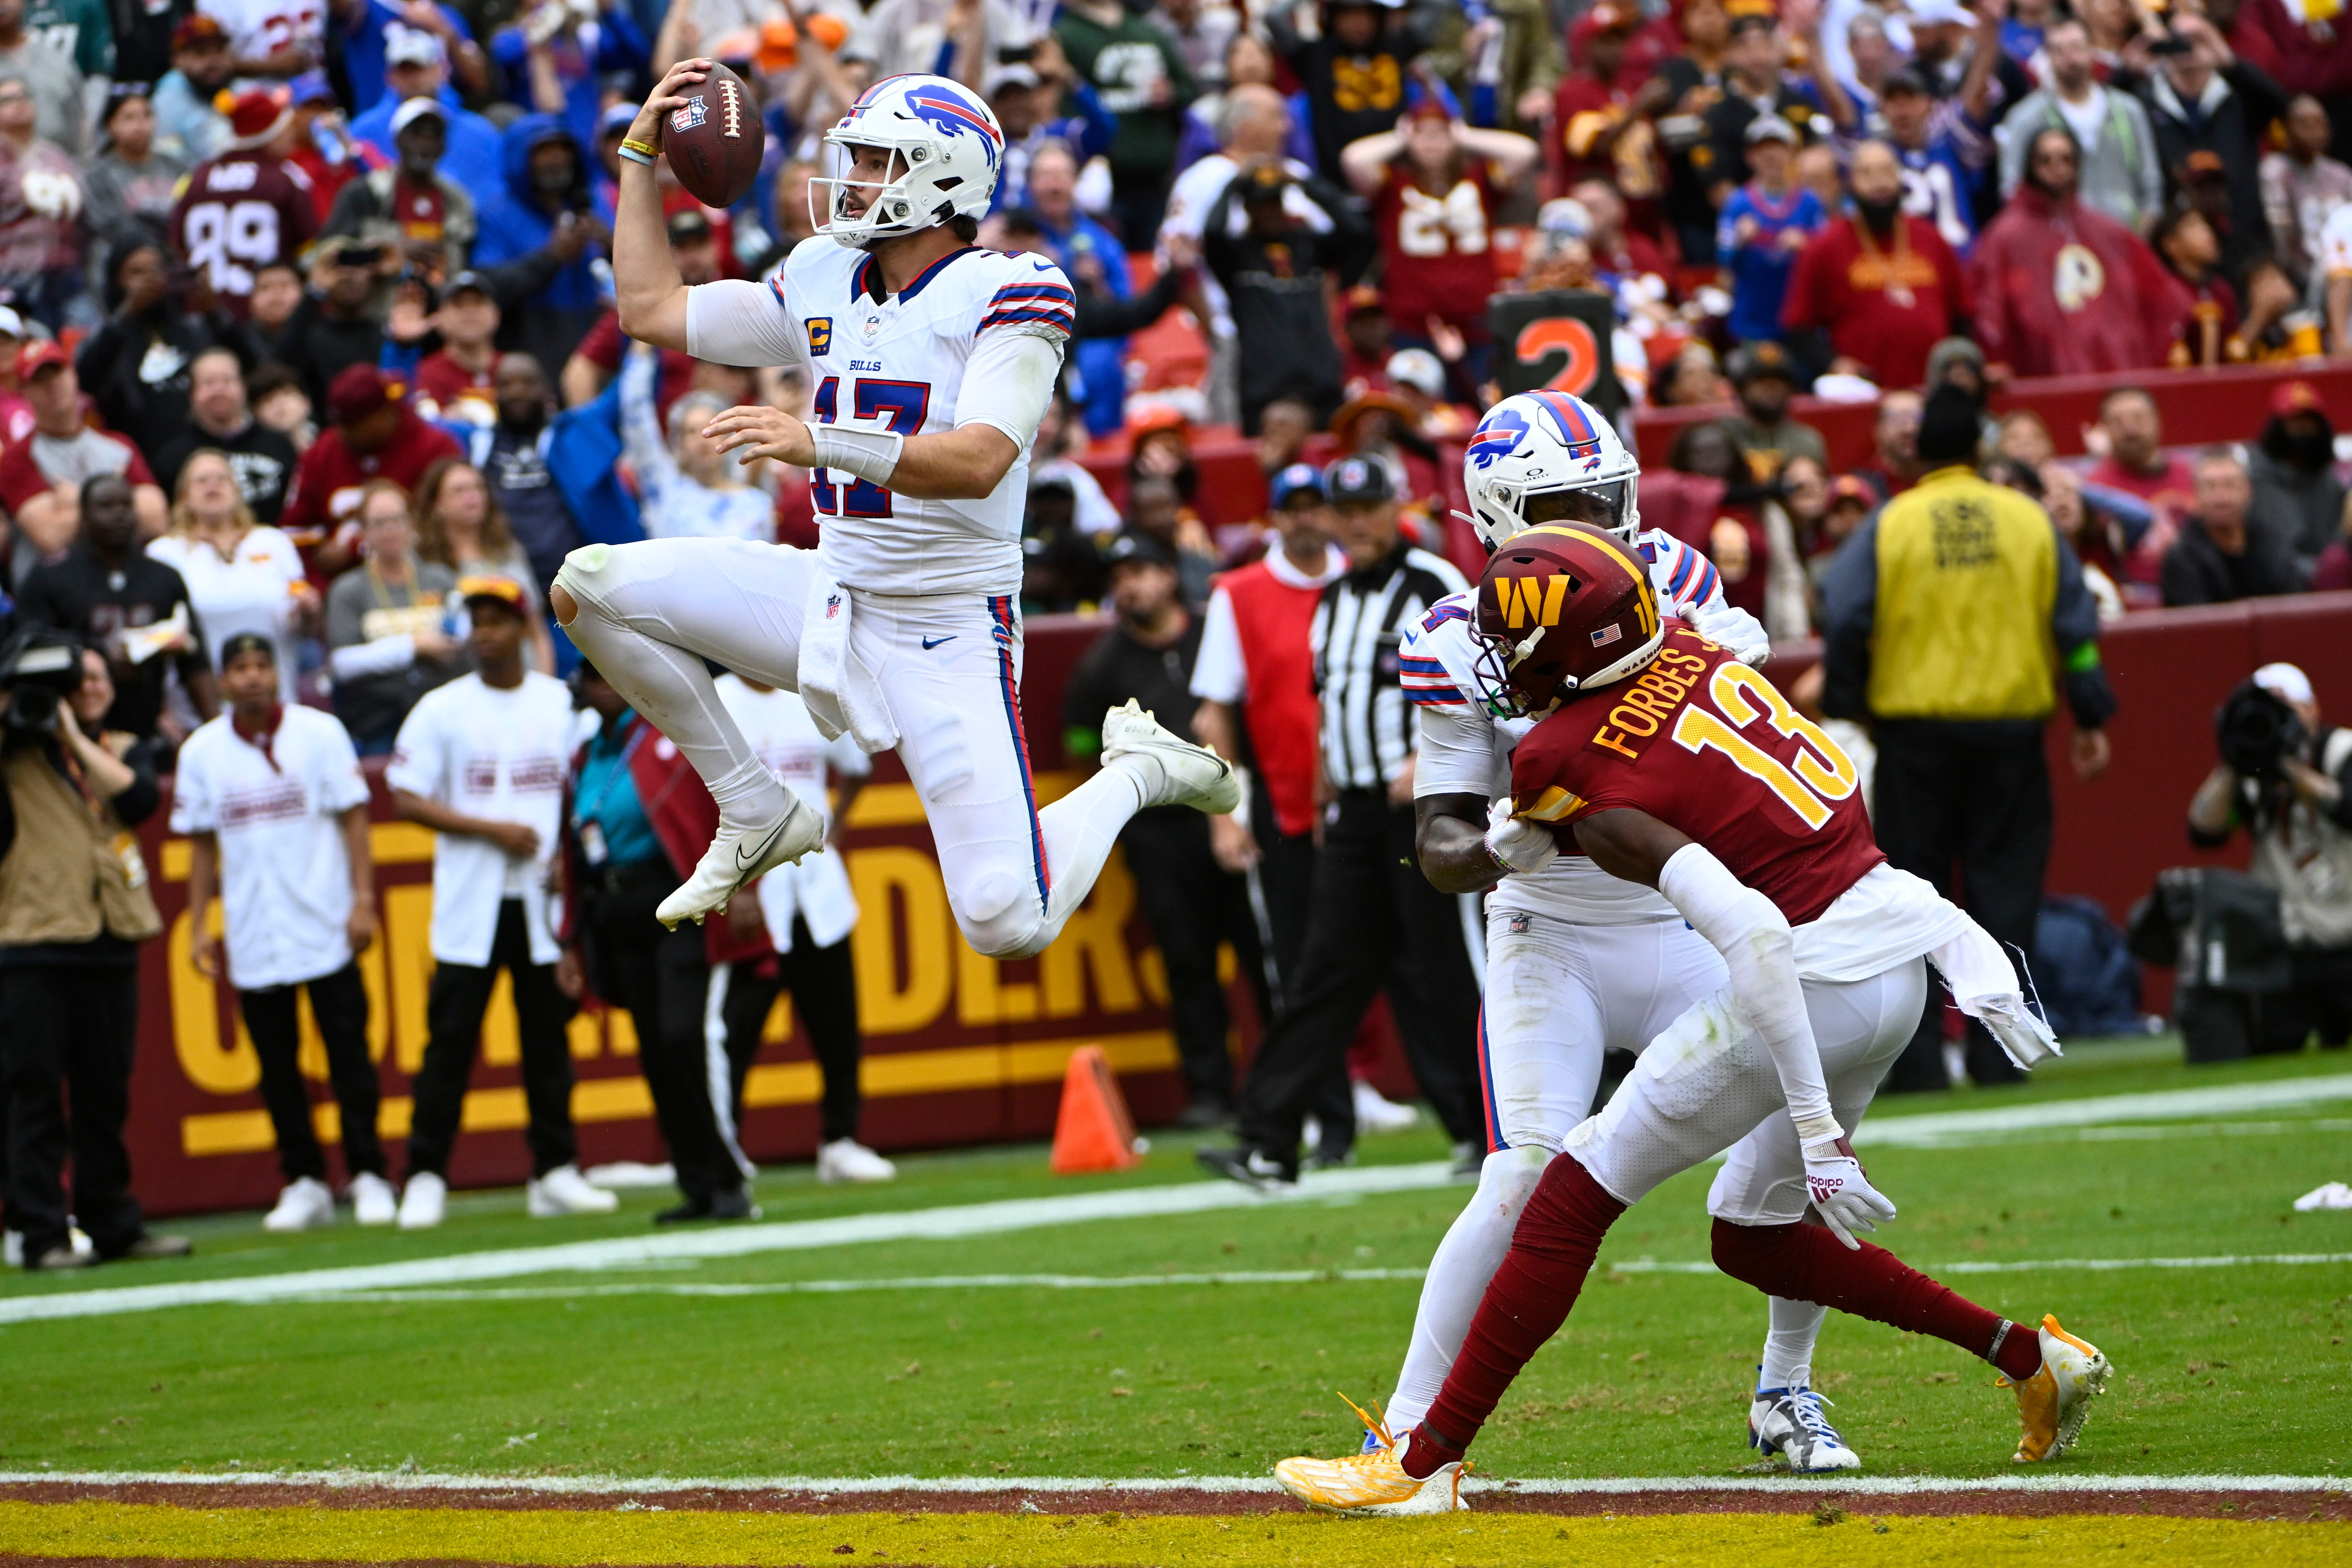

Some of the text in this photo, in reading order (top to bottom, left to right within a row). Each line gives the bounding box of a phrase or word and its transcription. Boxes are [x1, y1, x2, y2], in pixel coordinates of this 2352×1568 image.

[628, 152, 650, 164] STRONG
[1398, 180, 1488, 257] 24
[808, 319, 829, 346] C
[865, 323, 876, 333] NFL
[849, 360, 881, 371] BILLS
[1516, 316, 1599, 397] 2
[811, 376, 931, 518] 17
[1523, 473, 1549, 482] OAKLEY
[1634, 587, 1660, 635] 13
[1620, 642, 1665, 675] WASHIN
[1592, 648, 1707, 759] FORBES
[1671, 661, 1859, 831] 13
[1808, 1174, 1844, 1188] adidas
[1997, 1329, 2006, 1341] HE
